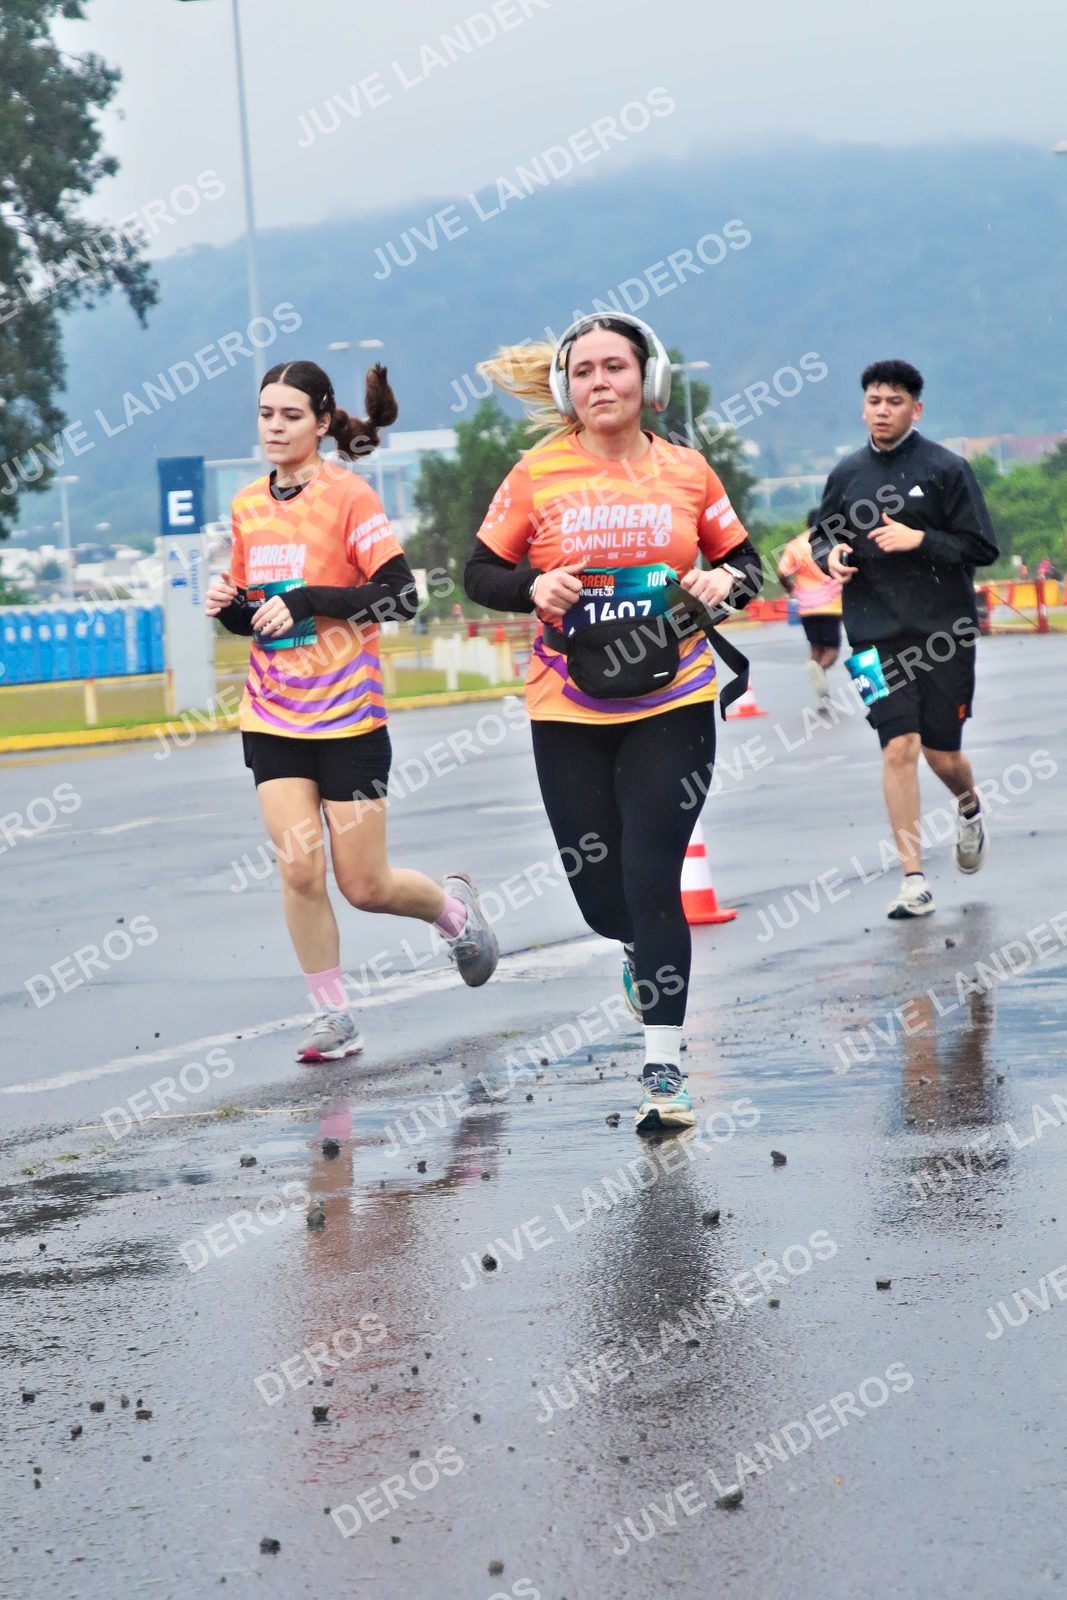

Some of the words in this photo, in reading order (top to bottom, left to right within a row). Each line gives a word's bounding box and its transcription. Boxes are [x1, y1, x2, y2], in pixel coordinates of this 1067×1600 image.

[168, 490, 195, 526] E
[561, 503, 672, 535] CARRERA
[561, 531, 647, 554] OMNILIFE
[647, 570, 668, 588] 10K
[584, 600, 652, 625] 1407
